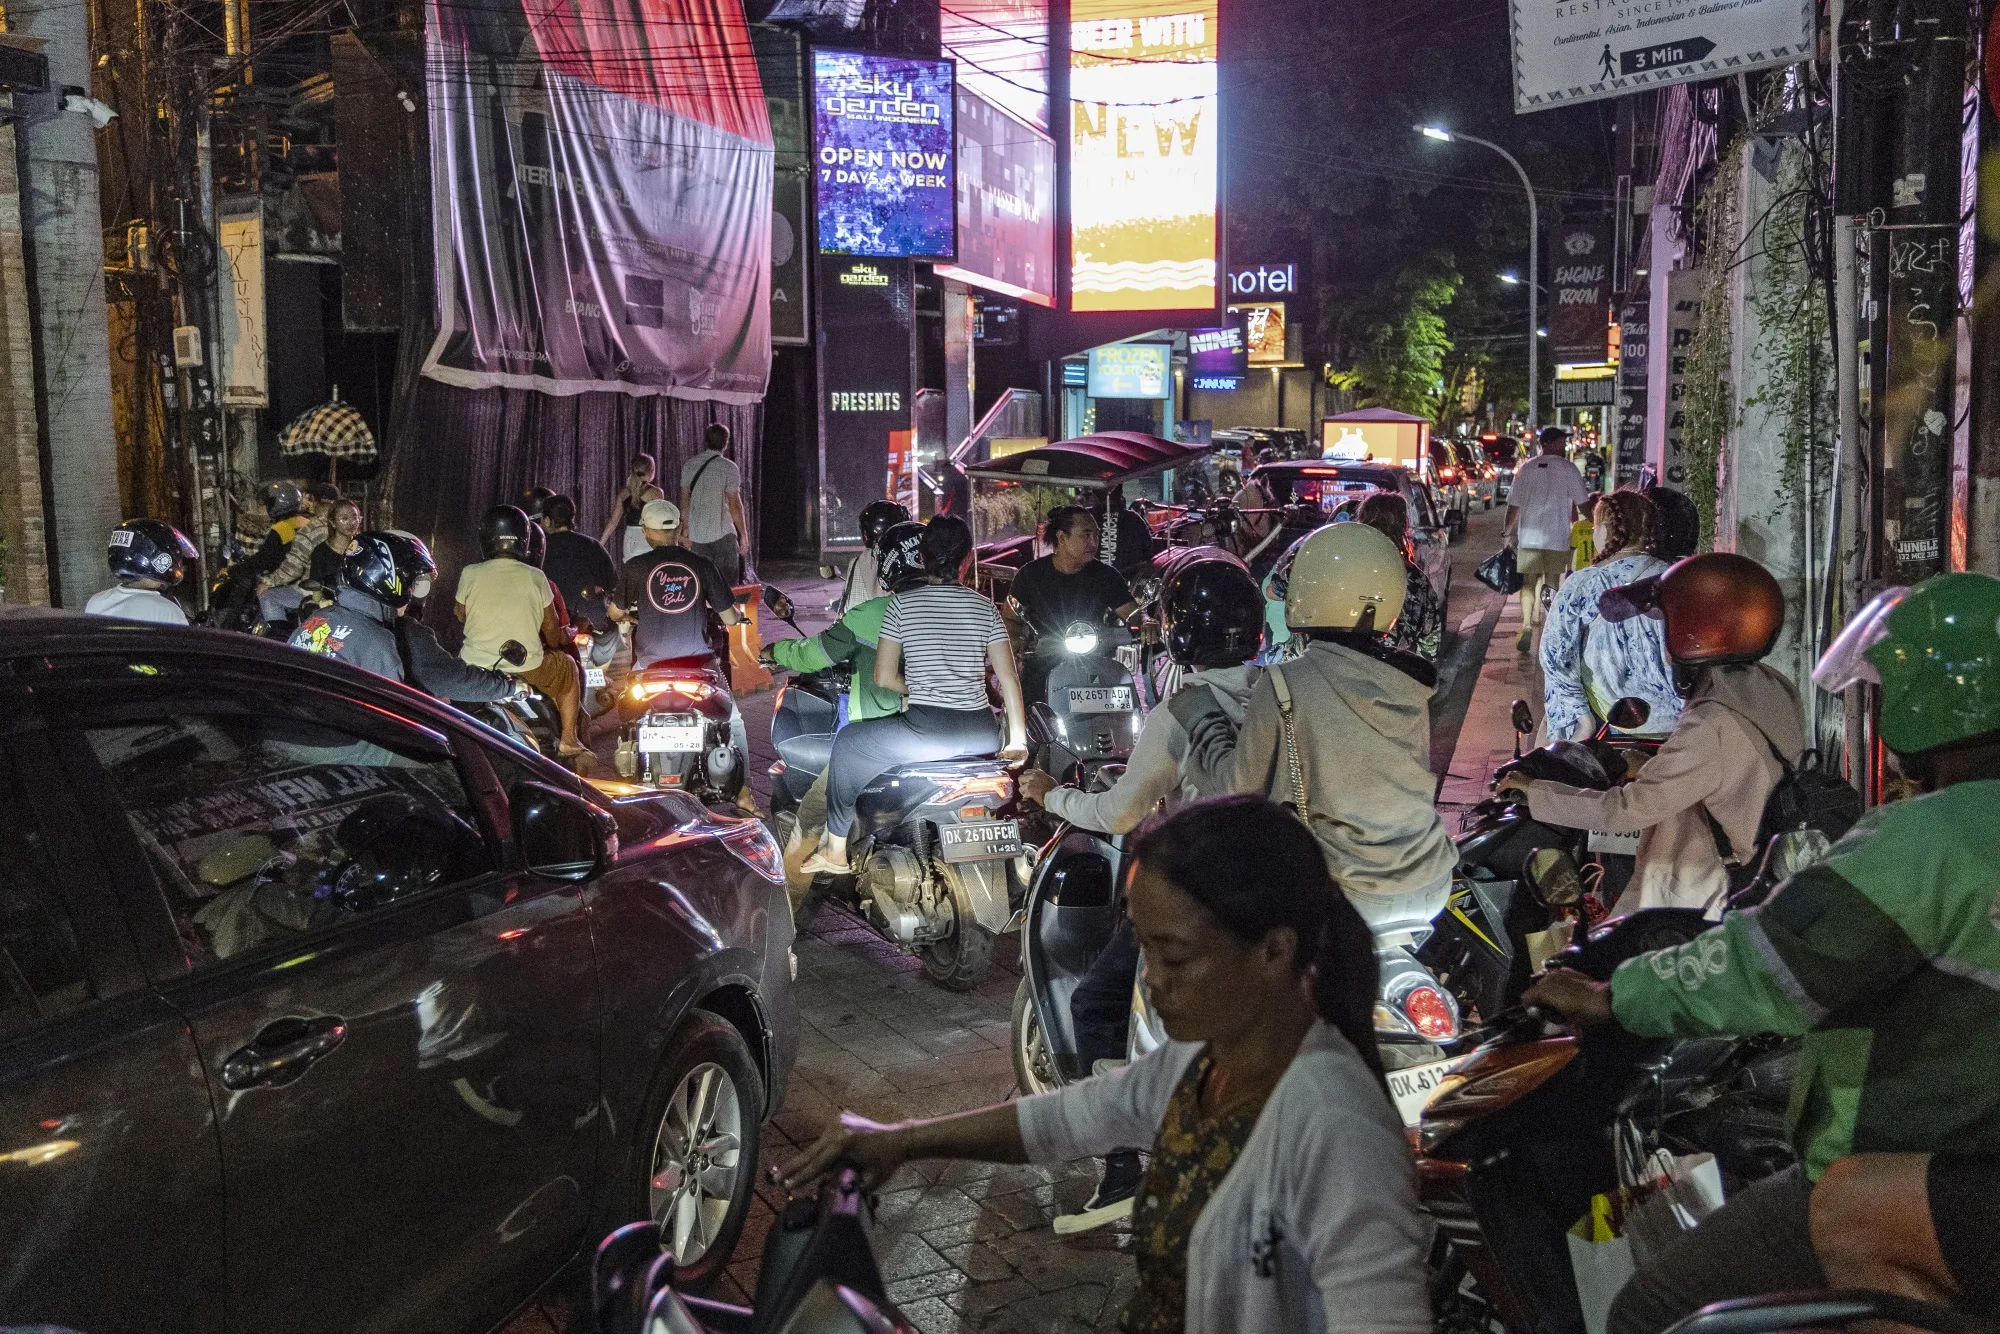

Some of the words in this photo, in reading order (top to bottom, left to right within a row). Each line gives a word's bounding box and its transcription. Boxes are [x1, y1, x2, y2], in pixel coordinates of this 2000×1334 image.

[1618, 2, 1662, 18] SINCE
[1637, 12, 1685, 29] Indonesian
[1698, 1, 1739, 15] Balinese
[1139, 13, 1205, 47] WITH
[1635, 52, 1646, 69] 3
[1652, 46, 1684, 65] Min
[854, 73, 912, 101] sky
[826, 96, 940, 119] garden
[846, 113, 873, 121] BALI
[875, 115, 940, 126] INDONESIA
[1074, 101, 1202, 158] NEW
[820, 146, 883, 167] OPEN
[891, 152, 947, 171] NOW
[821, 169, 831, 183] 7
[836, 170, 879, 186] DAYS
[900, 173, 947, 188] WEEK
[840, 273, 889, 285] garden
[852, 264, 877, 276] sky
[1554, 265, 1606, 285] ENGINE
[1559, 287, 1599, 305] ROOM
[1189, 328, 1242, 354] NINE
[1624, 343, 1646, 357] 100
[1096, 347, 1163, 364] FROZEN
[1098, 364, 1141, 377] YOGURT
[831, 392, 900, 411] PRESENTS
[1899, 539, 1938, 553] JUNGLE
[656, 570, 692, 588] Young
[661, 591, 686, 606] Bali
[1070, 690, 1084, 701] DK
[1085, 689, 1108, 700] 2657
[946, 829, 962, 844] DK
[965, 828, 993, 842] 2670
[994, 825, 1015, 841] FCH
[1390, 1074, 1417, 1098] DK
